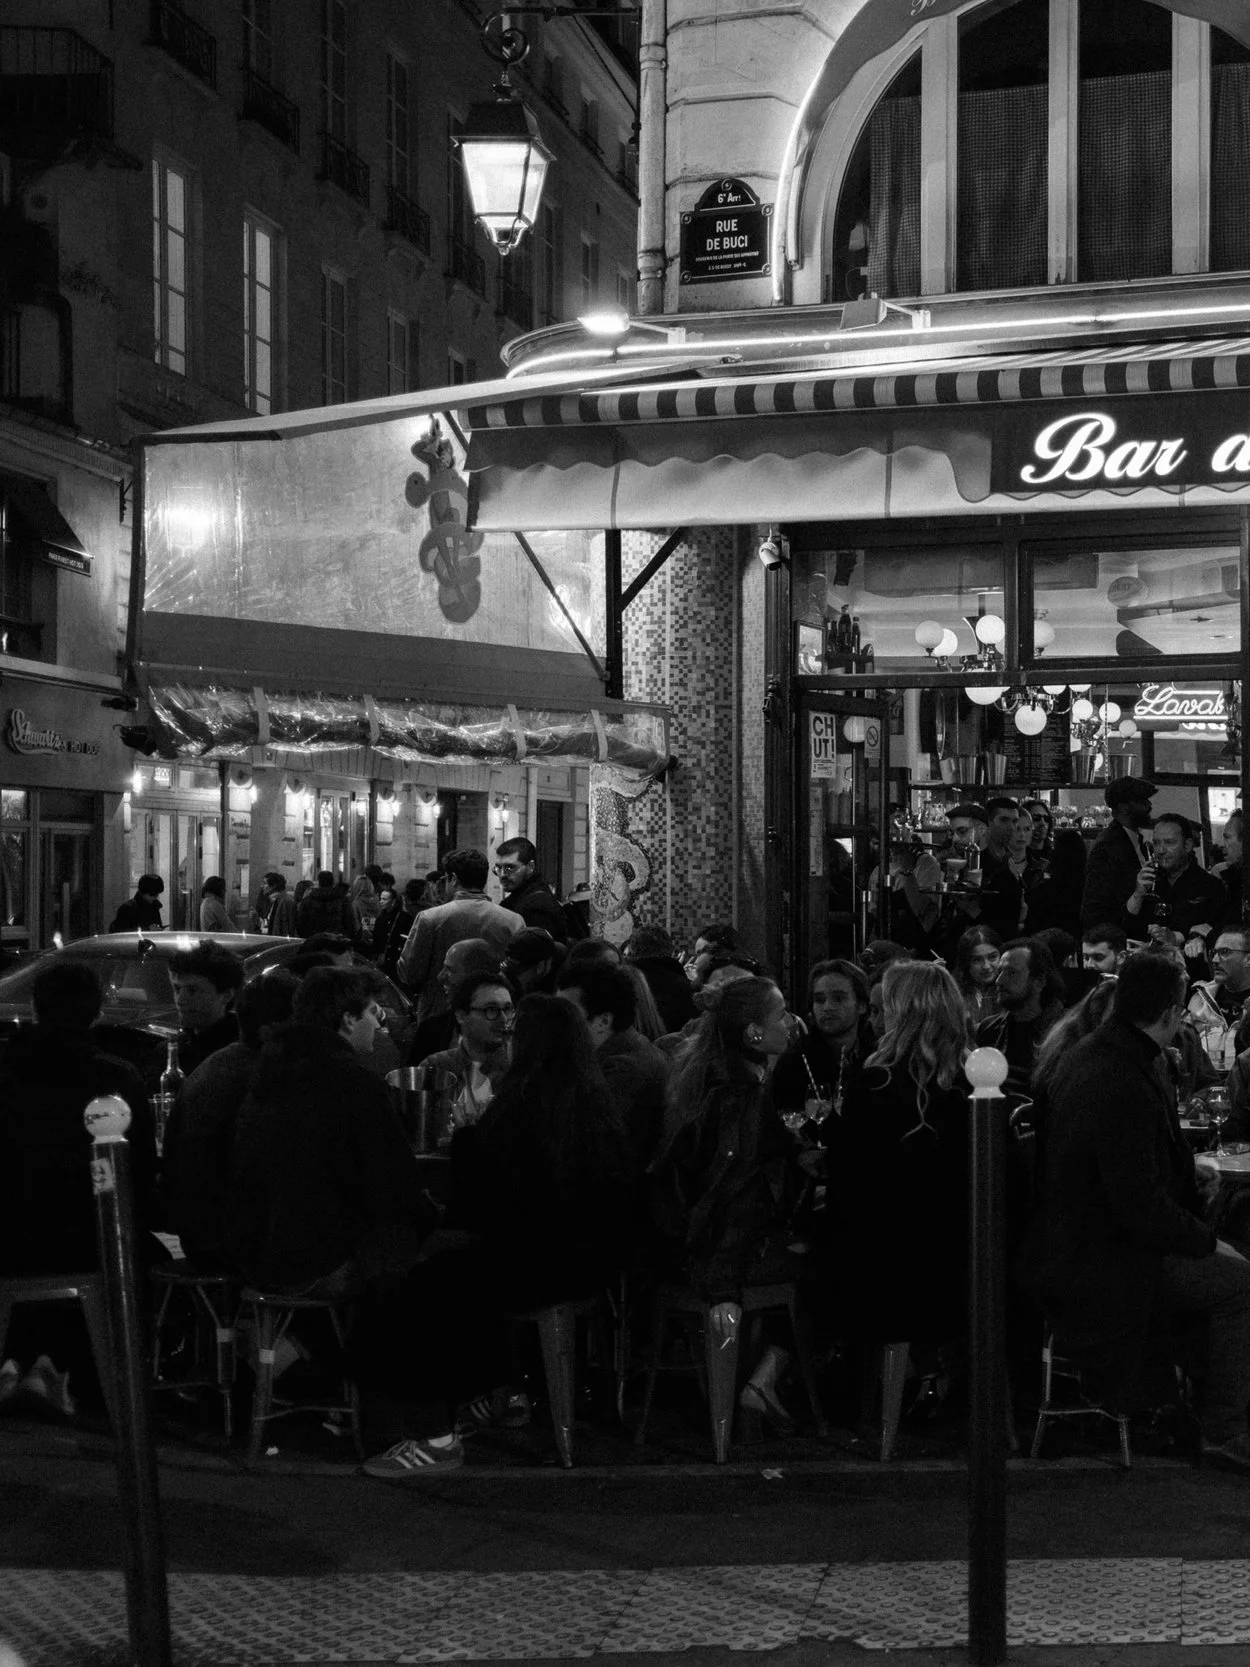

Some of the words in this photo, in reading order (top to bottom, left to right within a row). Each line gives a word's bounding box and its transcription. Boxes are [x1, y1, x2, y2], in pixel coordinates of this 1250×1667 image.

[716, 219, 738, 233] RUE
[706, 238, 720, 251] DE
[723, 235, 748, 249] BUCI
[1019, 412, 1188, 485] Bar
[812, 715, 834, 737] CH
[813, 738, 835, 759] UT!
